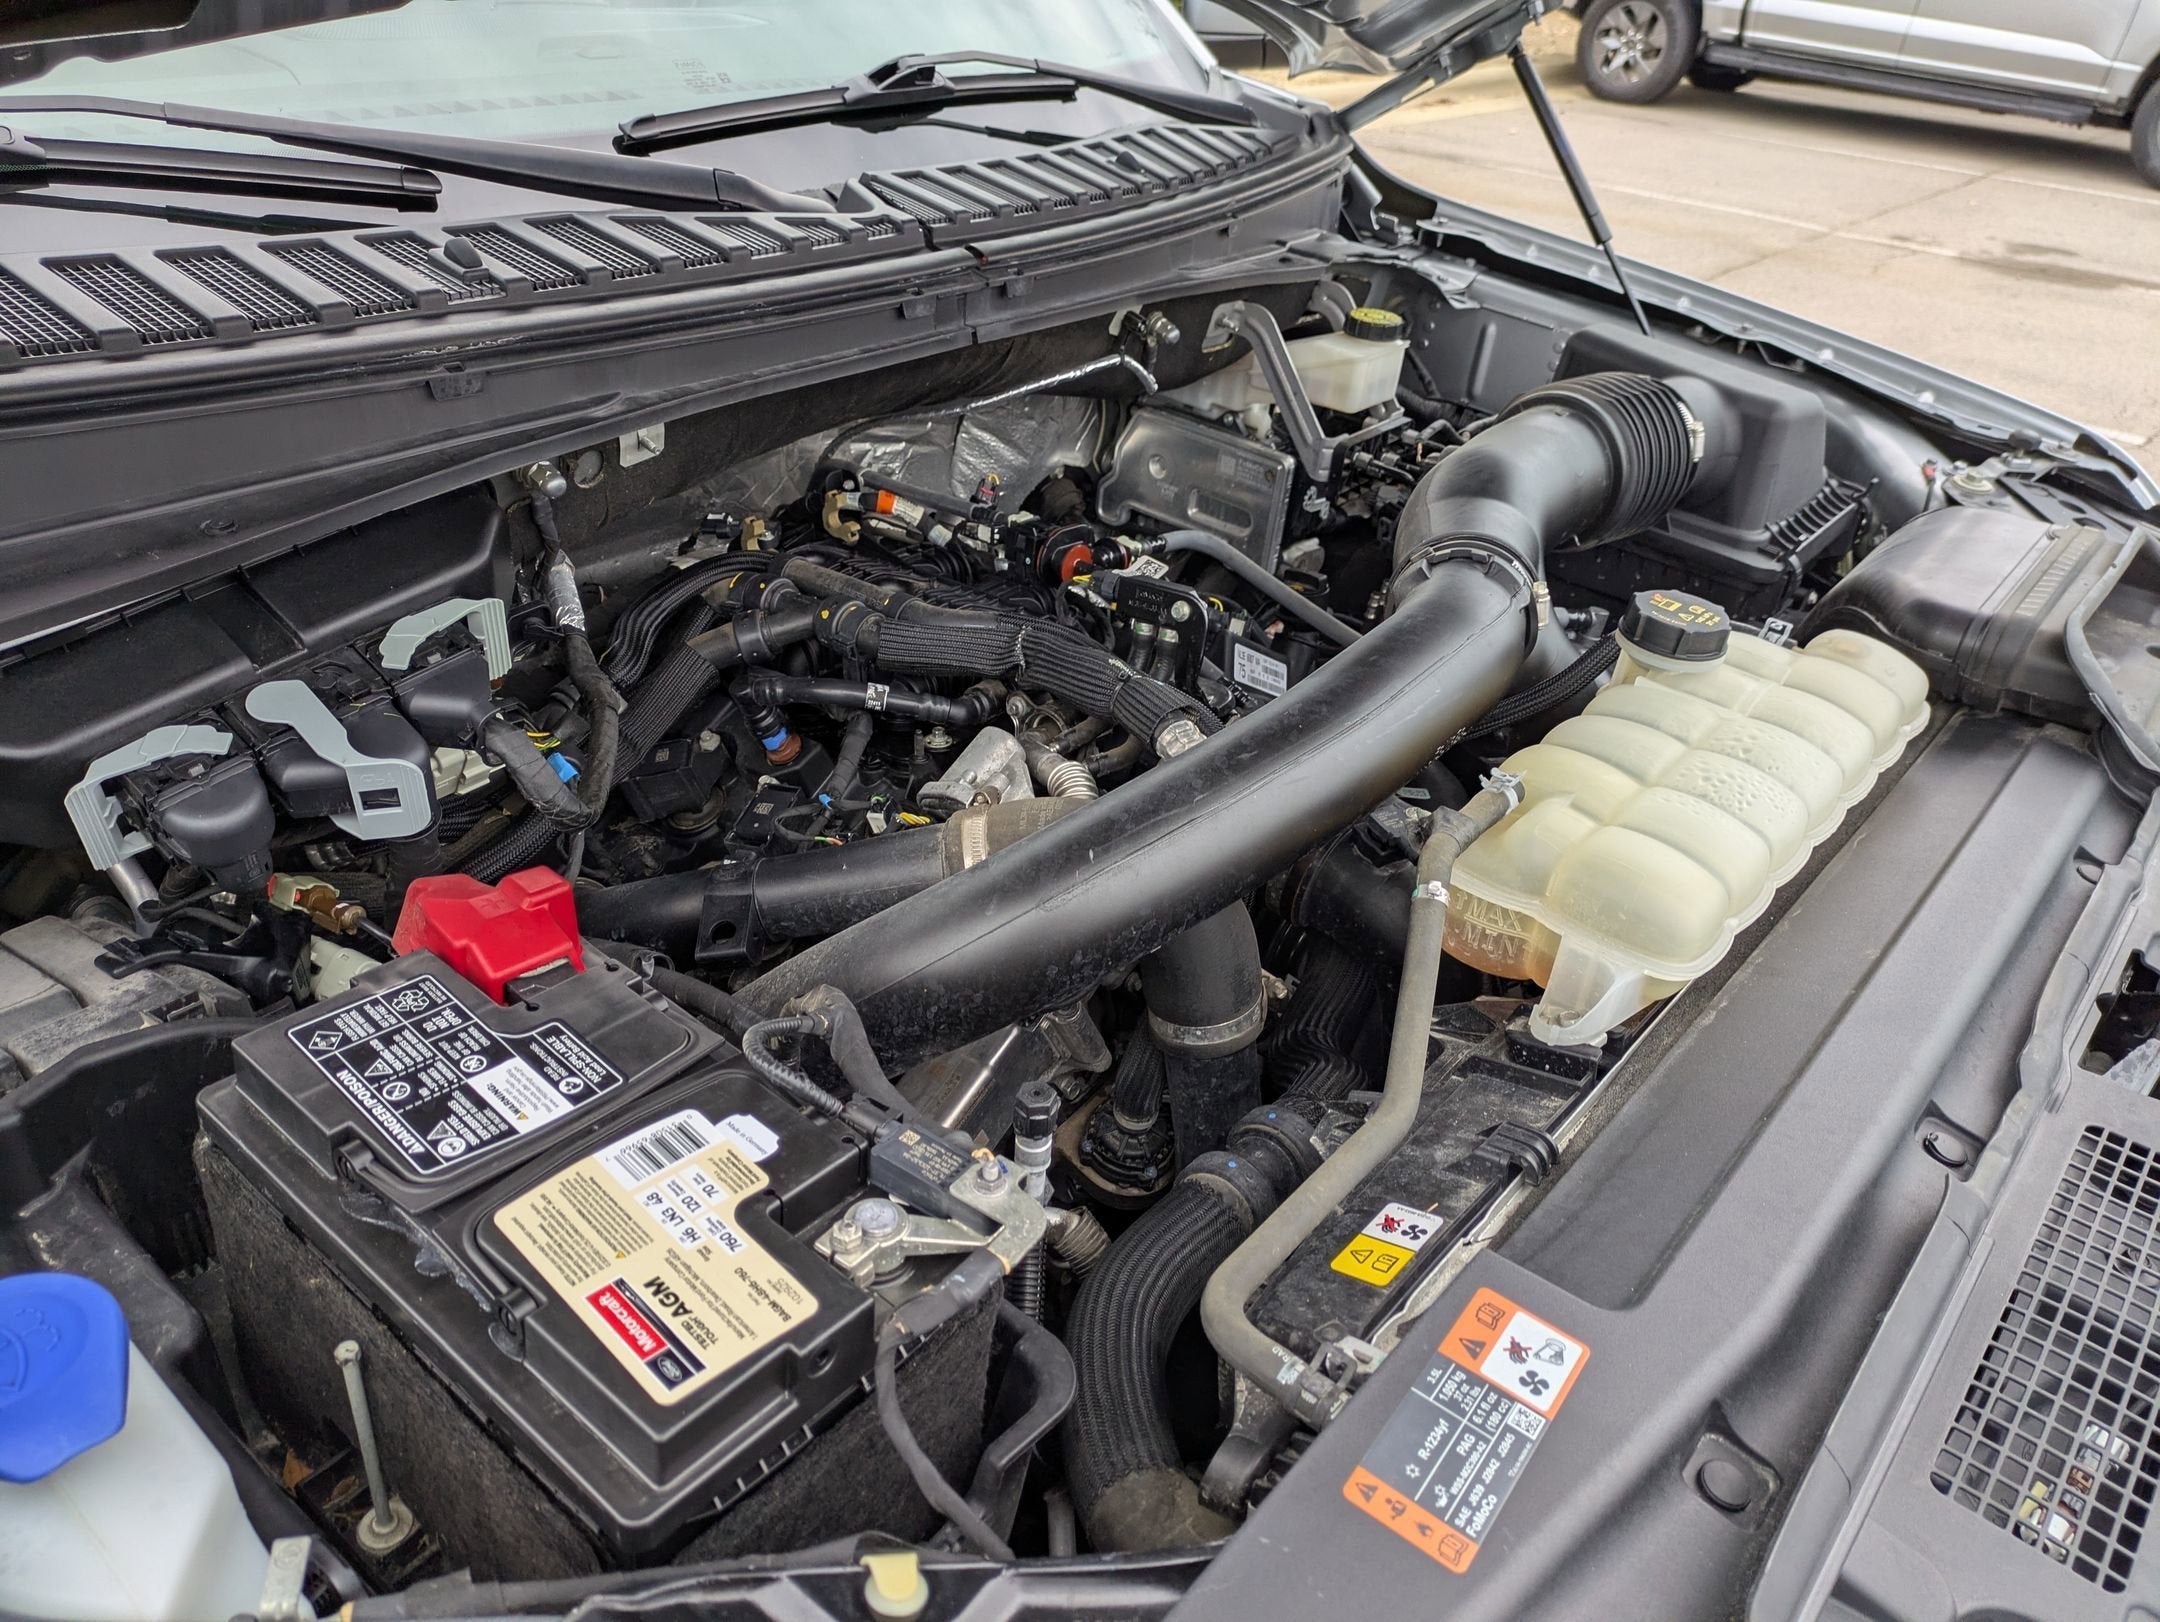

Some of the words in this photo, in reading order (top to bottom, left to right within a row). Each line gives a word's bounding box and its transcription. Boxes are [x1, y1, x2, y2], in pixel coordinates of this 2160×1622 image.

[1466, 899, 1522, 932] MAX
[382, 1012, 399, 1024] HELP
[420, 1020, 438, 1032] DO
[429, 1014, 451, 1029] NOT
[438, 1007, 463, 1025] OPEN.
[367, 1038, 386, 1051] ACID
[387, 1043, 407, 1058] CAUSE
[397, 1039, 425, 1062] BLINDNESS
[413, 1041, 434, 1058] SEVERE
[436, 1039, 452, 1050] OUT
[445, 1048, 462, 1060] KEEP
[451, 1040, 466, 1050] THE
[462, 1036, 482, 1051] REACH
[557, 1033, 583, 1053] Battery
[378, 1048, 406, 1071] SULFURIC
[400, 1055, 415, 1066] CAN
[526, 1041, 570, 1077] INSTRUCTIONS.
[545, 1034, 602, 1082] NON-SPILLABLE
[576, 1050, 594, 1063] Acid
[541, 1065, 562, 1081] READ
[588, 1061, 608, 1075] Lead
[416, 1086, 432, 1097] NO
[449, 1089, 479, 1114] BLINDNESS
[483, 1082, 522, 1115] WARNING:
[334, 1068, 418, 1147] DANGER/POISON
[471, 1110, 492, 1127] CAUSE
[457, 1126, 481, 1146] SHIELD
[460, 1113, 492, 1140] EXPLOSIVE
[485, 1123, 501, 1135] CAN
[727, 1120, 741, 1133] Made
[746, 1135, 768, 1155] Germany
[644, 1190, 665, 1207] 48
[700, 1182, 720, 1198] 70
[679, 1193, 702, 1213] 120
[659, 1205, 685, 1227] LN3
[679, 1225, 702, 1244] H6
[717, 1230, 743, 1252] 760
[662, 1254, 687, 1279] Company
[677, 1258, 702, 1282] Michigan
[681, 1275, 698, 1290] Motor
[641, 1274, 693, 1322] AGM
[693, 1287, 708, 1301] Ford
[732, 1264, 792, 1324] BAGM-48H6-760
[594, 1290, 658, 1353] Motorcraft
[710, 1304, 746, 1340] Manufactured
[729, 1312, 756, 1337] American
[679, 1319, 711, 1350] TESTED
[1437, 1378, 1458, 1402] 1.050
[1450, 1368, 1467, 1385] kg
[1452, 1390, 1465, 1402] 37
[1459, 1382, 1470, 1394] oz
[1459, 1394, 1475, 1412] 2.31
[1468, 1384, 1482, 1398] lbs
[1471, 1407, 1487, 1424] 6.1
[1479, 1400, 1491, 1411] fl
[1485, 1390, 1498, 1404] oz
[1484, 1410, 1504, 1433] (180
[1495, 1396, 1512, 1415] cc)
[1416, 1417, 1452, 1462] R-1234yf
[1454, 1431, 1476, 1457] PAG
[1453, 1505, 1472, 1529] SAE
[1465, 1482, 1486, 1508] J639
[1479, 1457, 1501, 1485] J2842
[1494, 1431, 1516, 1458] J2845
[1464, 1491, 1498, 1538] FoMoCo
